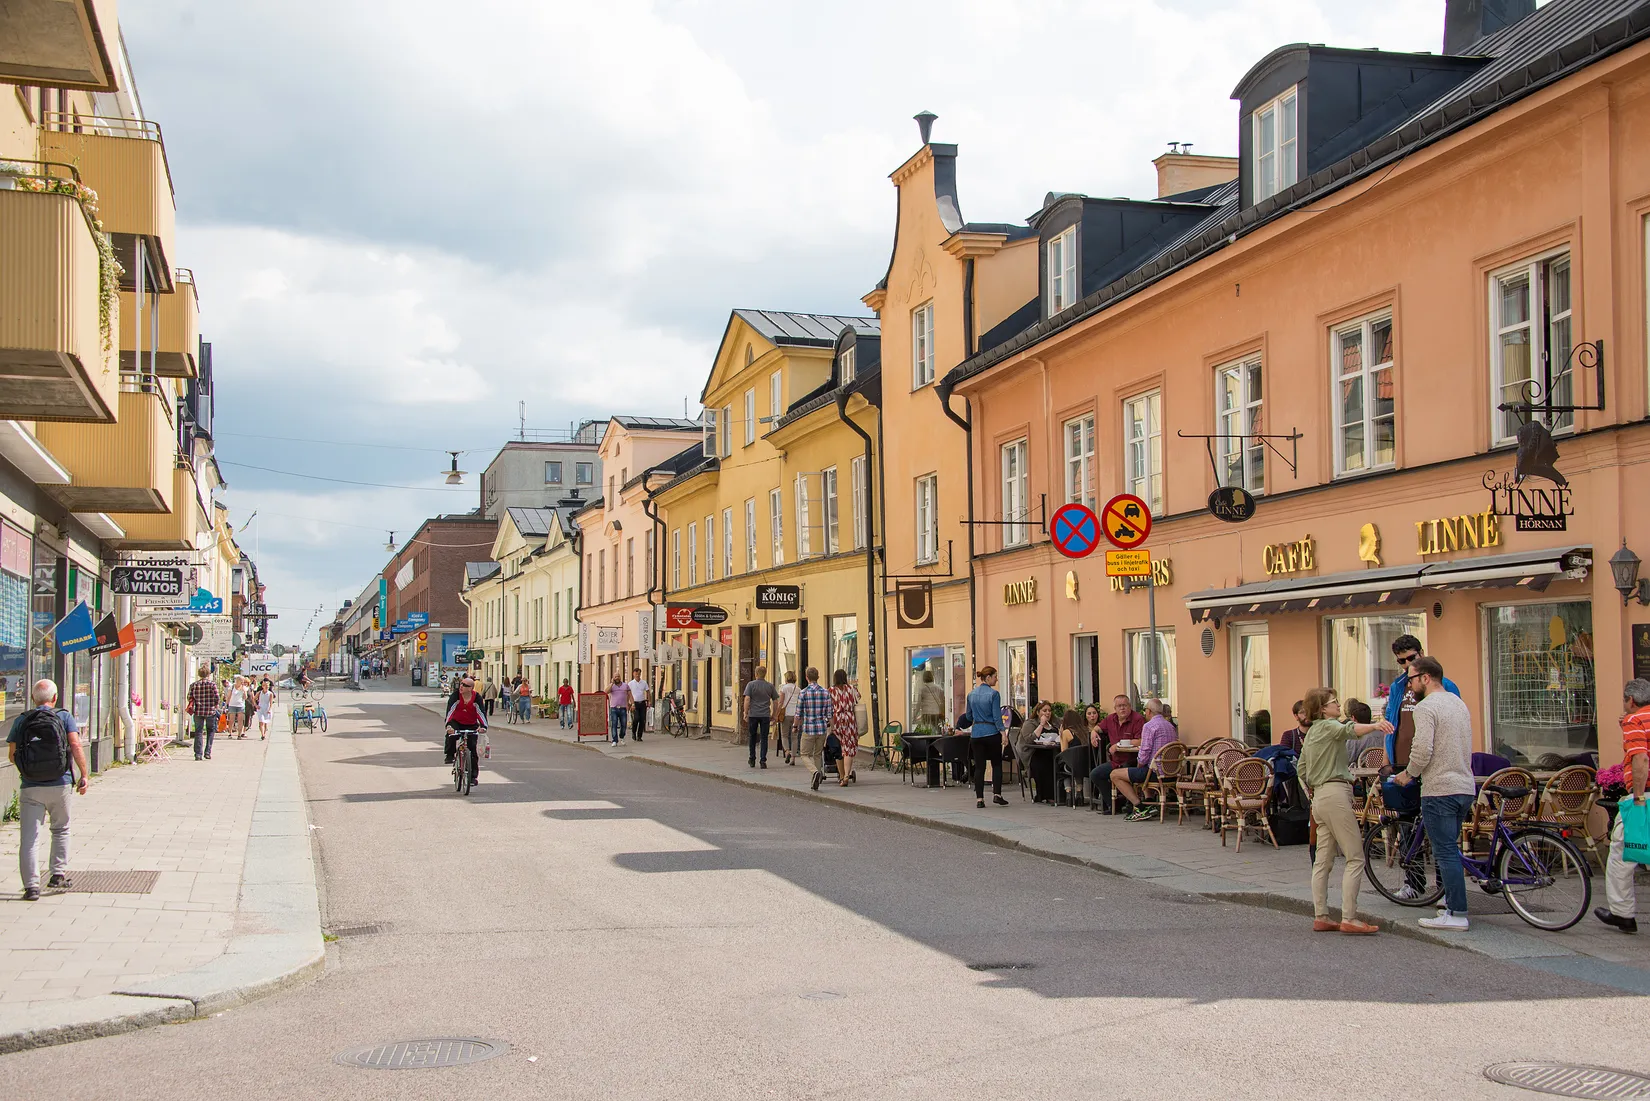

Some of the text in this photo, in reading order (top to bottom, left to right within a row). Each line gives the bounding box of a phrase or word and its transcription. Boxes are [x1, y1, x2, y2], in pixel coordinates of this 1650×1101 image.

[1490, 482, 1575, 515] LINNÉ
[1215, 504, 1246, 516] LINNÉ
[1519, 517, 1563, 529] HÖRNAN
[1262, 504, 1499, 575] CAFÉ LINNÉ
[1123, 559, 1149, 567] linjetrafik
[133, 570, 177, 581] CYKEL
[130, 581, 179, 594] VIKTOR
[1002, 575, 1036, 607] LINNÉ
[62, 633, 93, 646] MONARK
[91, 641, 117, 651] TREK
[250, 664, 272, 672] NCC
[1624, 842, 1648, 850] WEEKDAY
